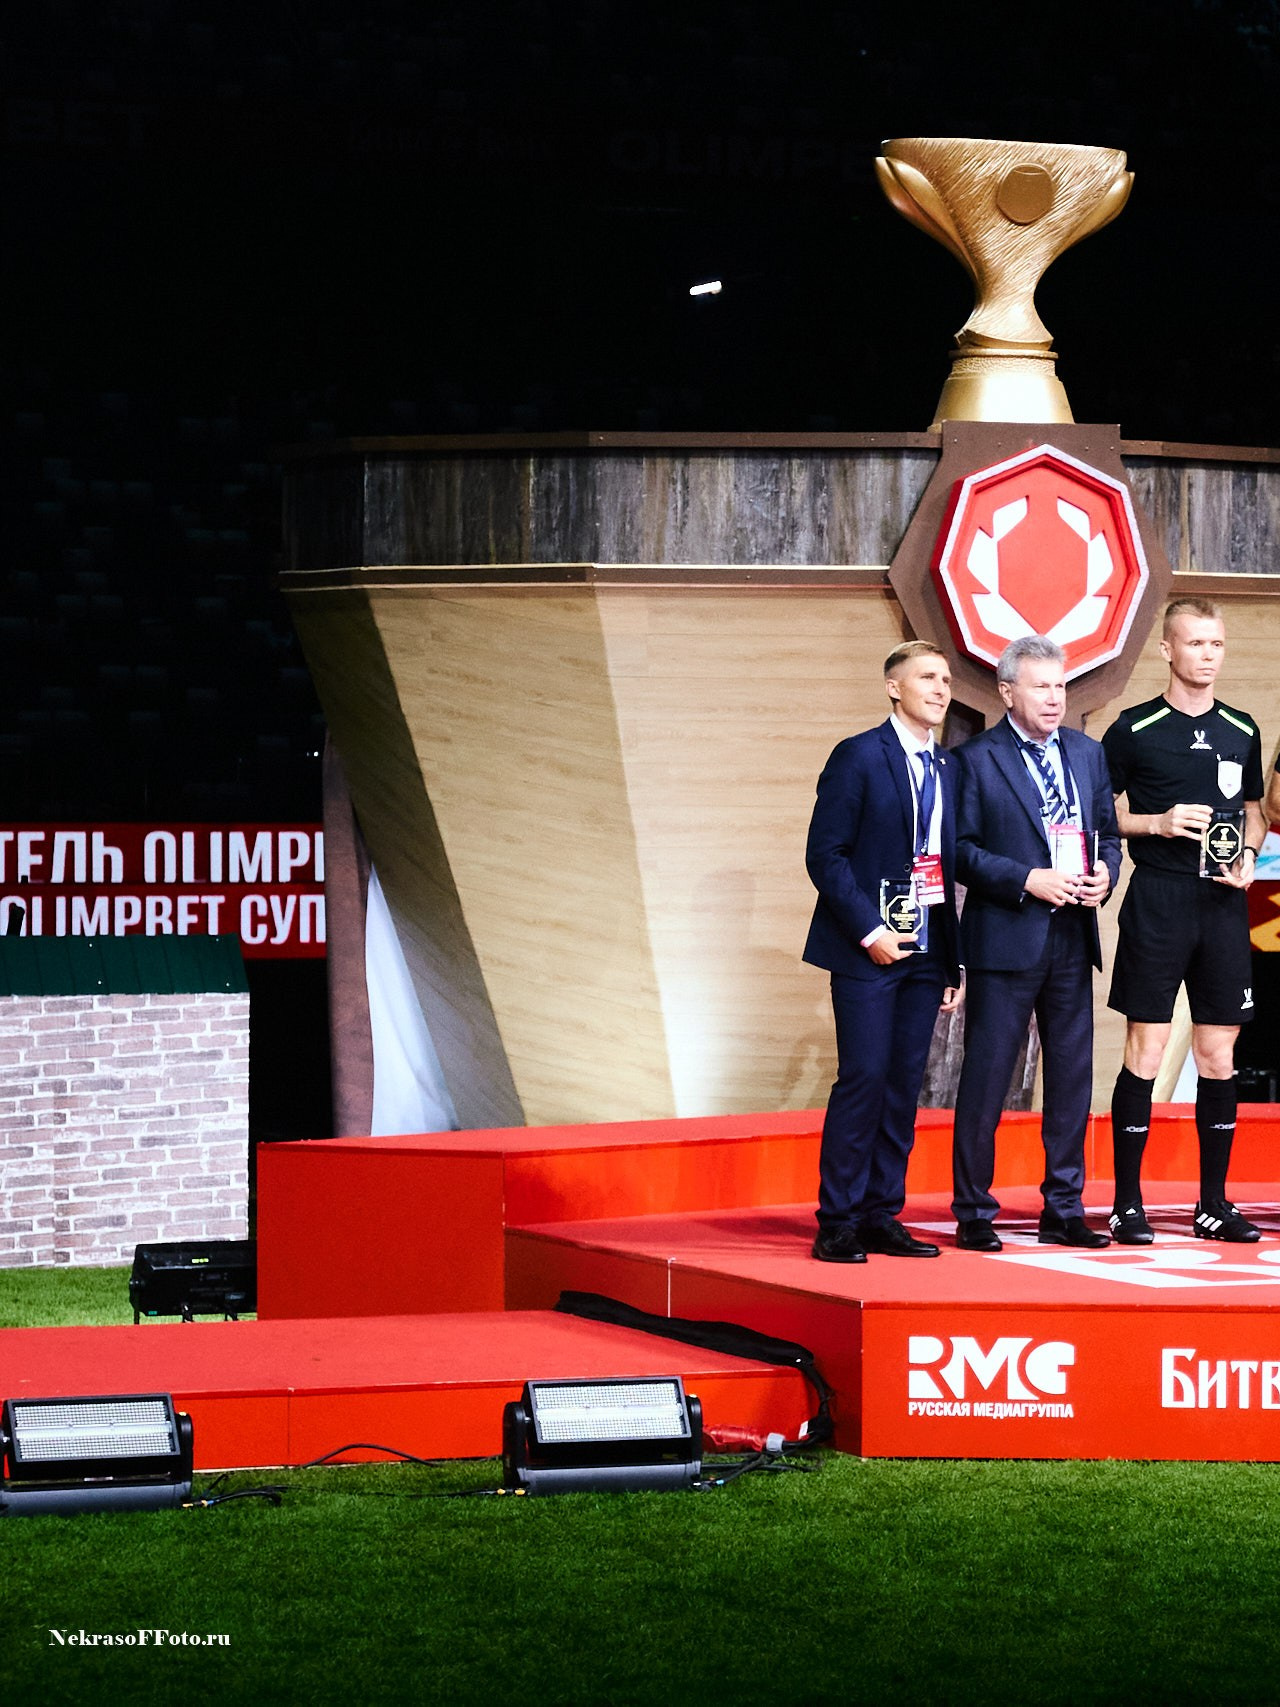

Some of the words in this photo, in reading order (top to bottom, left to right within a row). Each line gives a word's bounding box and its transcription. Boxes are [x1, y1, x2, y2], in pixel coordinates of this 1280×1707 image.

[908, 1335, 1075, 1400] RMG
[908, 1401, 970, 1416] РУССКАЯ
[973, 1402, 1074, 1419] МЕДИАГРУППА
